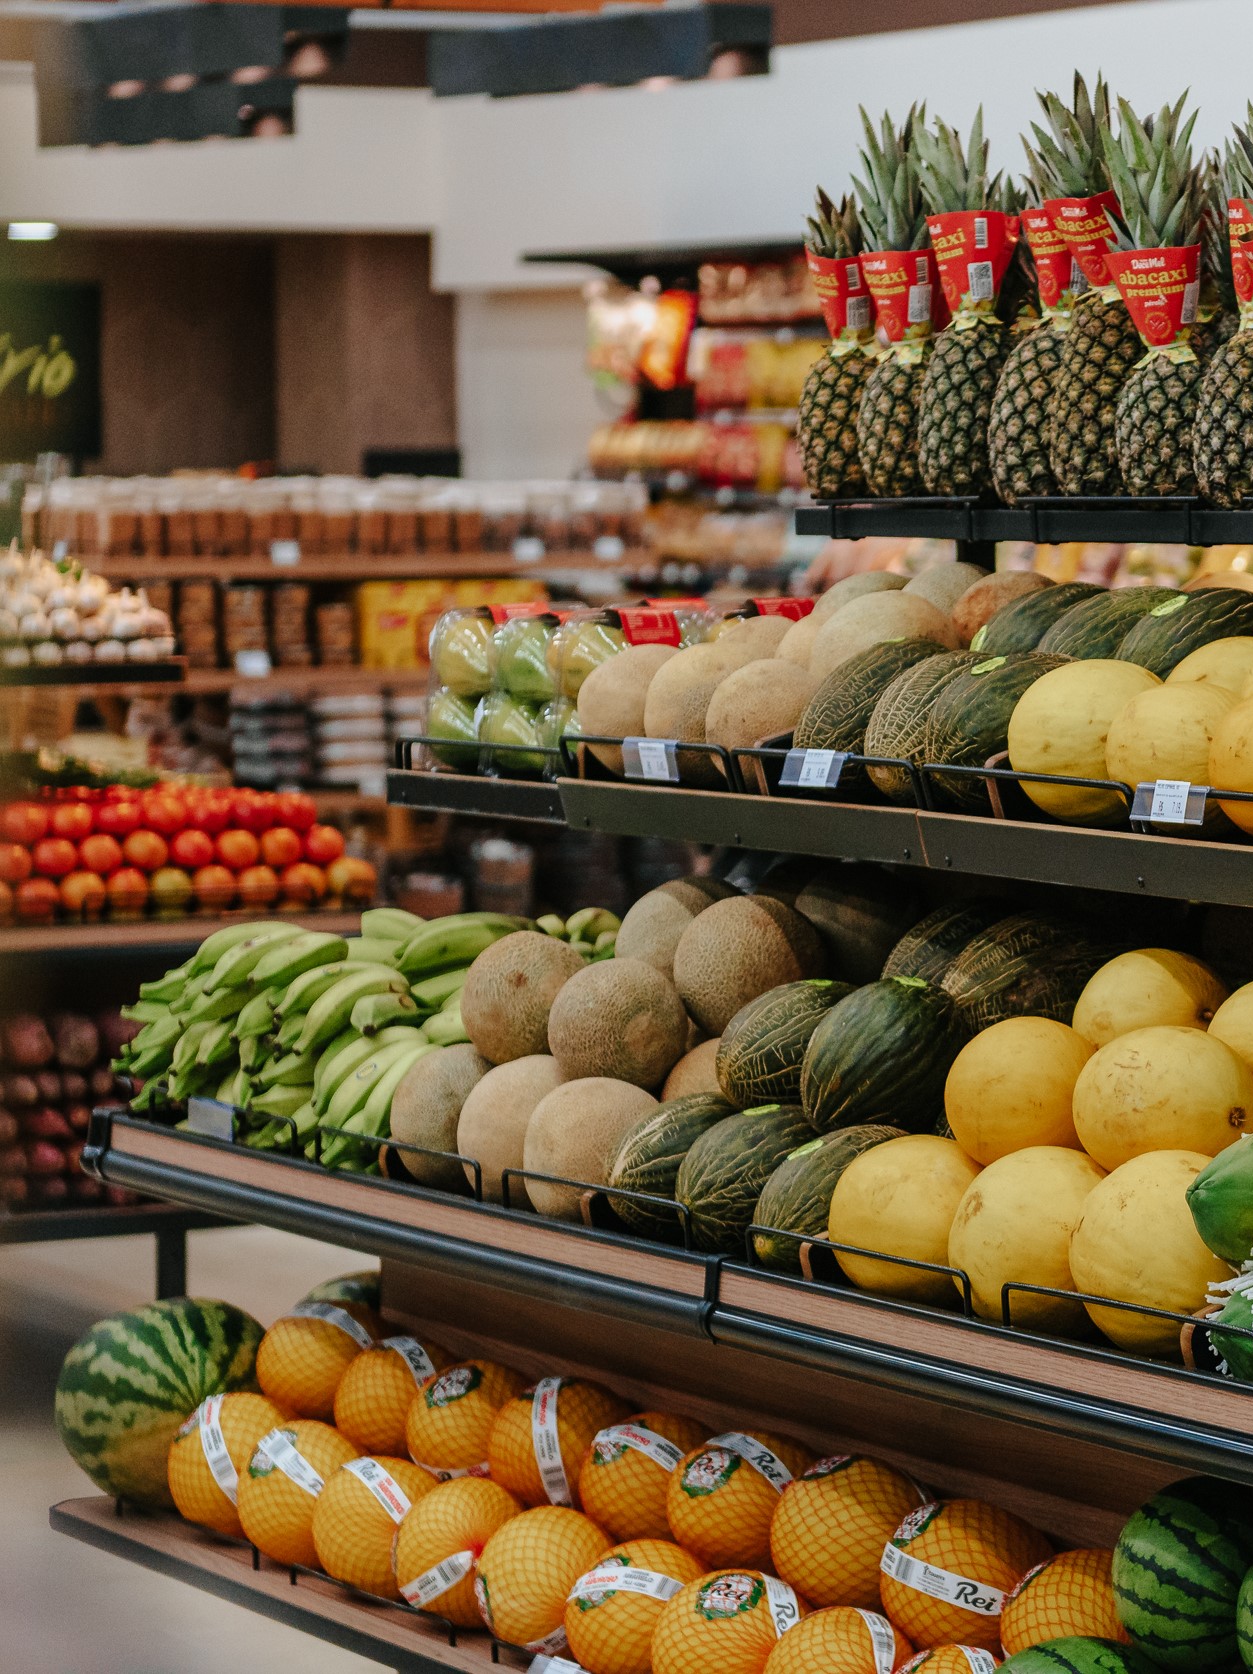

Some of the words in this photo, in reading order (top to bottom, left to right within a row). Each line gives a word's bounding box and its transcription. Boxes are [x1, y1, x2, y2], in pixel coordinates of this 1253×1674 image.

[1119, 263, 1188, 285] abacaxi
[1126, 284, 1185, 298] premium
[751, 1451, 783, 1482] Rei
[953, 1581, 997, 1612] Rei
[775, 1602, 796, 1635] Re
